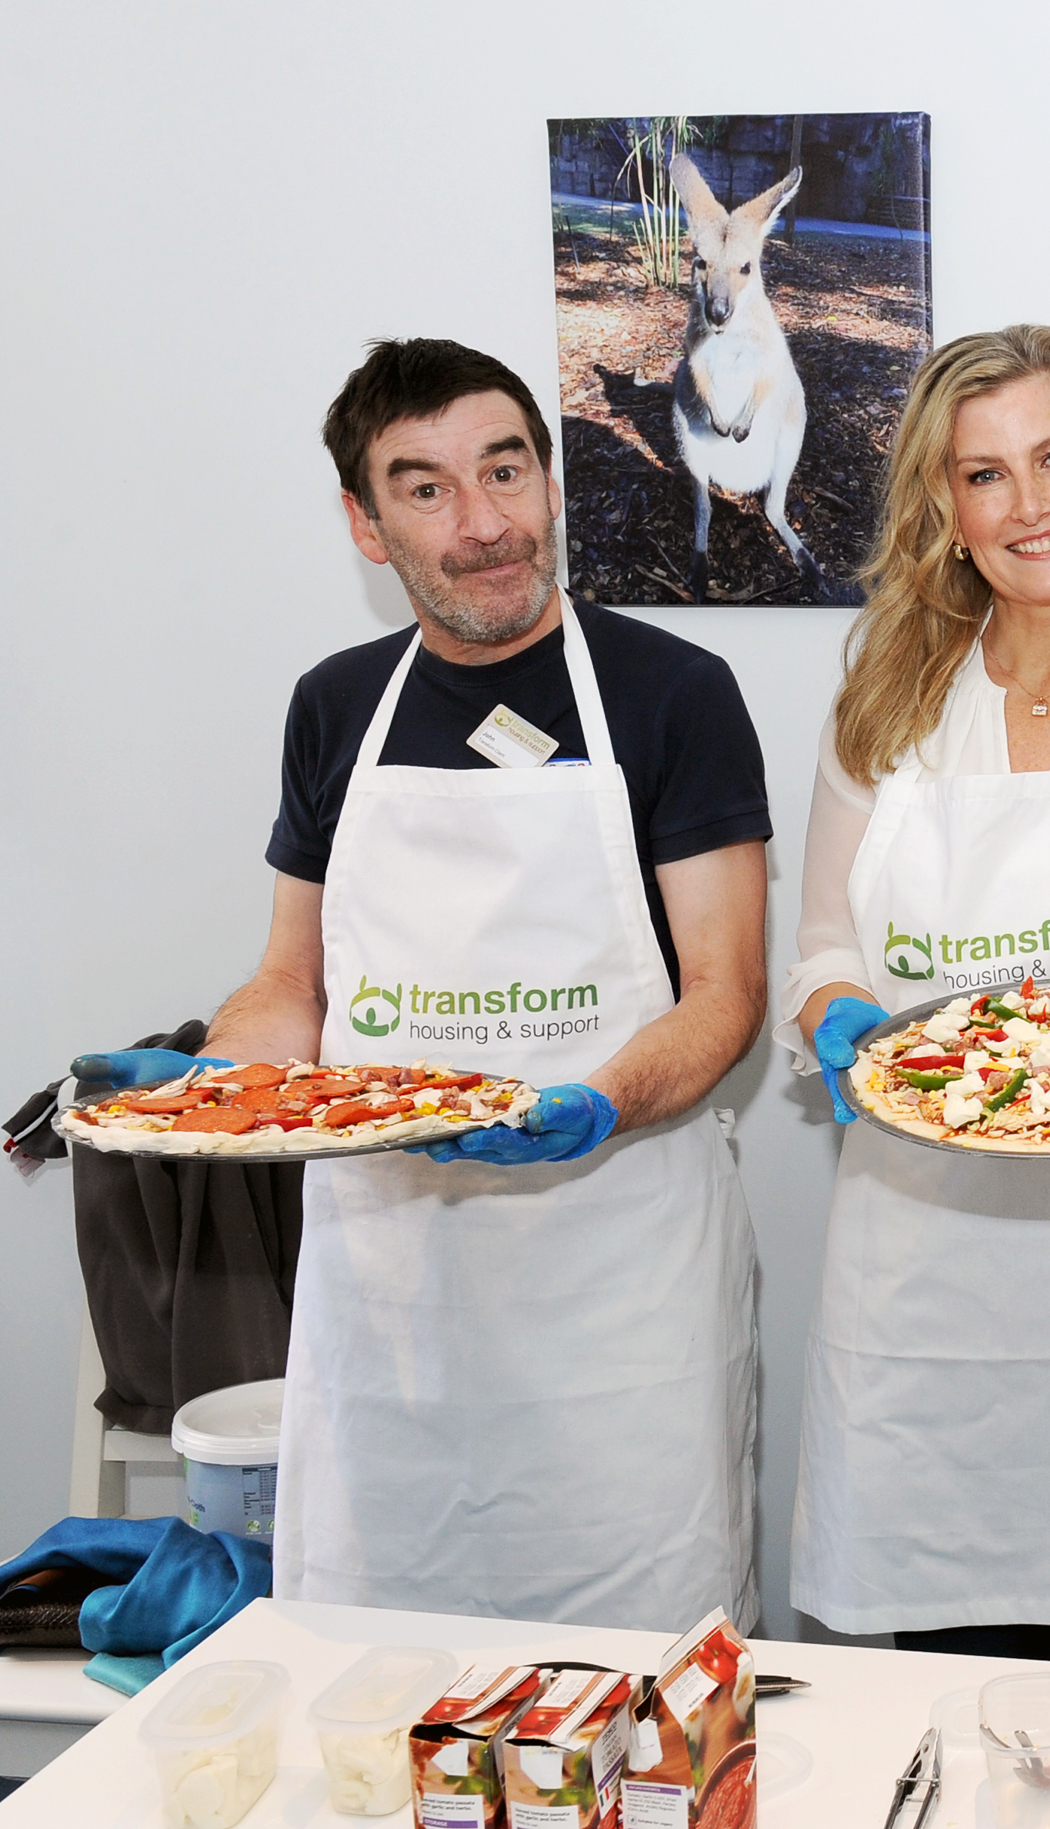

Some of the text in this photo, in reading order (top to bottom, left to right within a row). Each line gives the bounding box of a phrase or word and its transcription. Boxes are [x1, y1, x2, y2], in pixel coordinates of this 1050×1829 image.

[943, 964, 1025, 989] housing
[1031, 959, 1046, 978] &
[409, 982, 599, 1015] transform
[409, 1014, 600, 1045] housing & support
